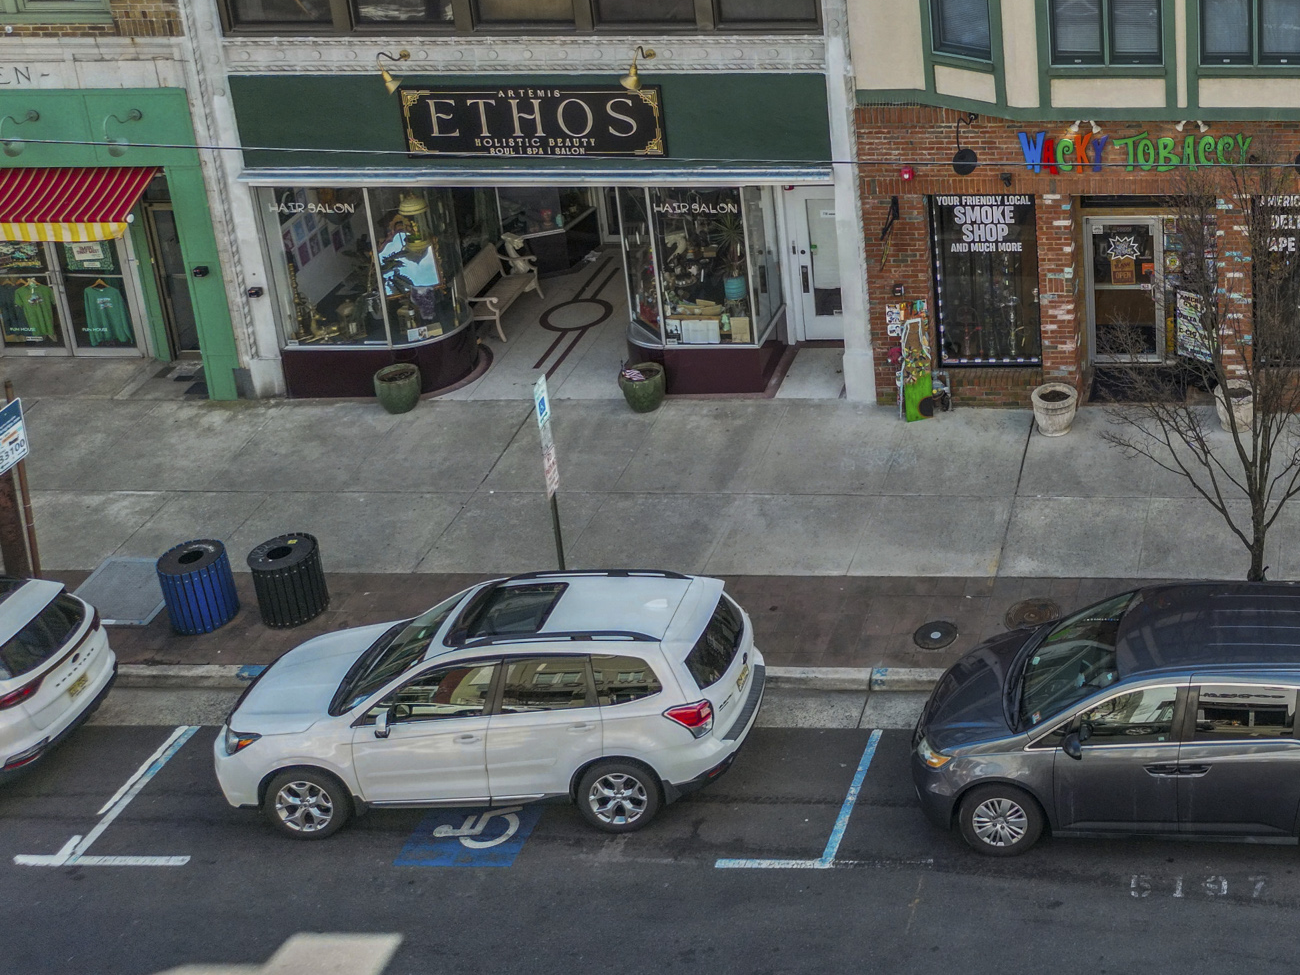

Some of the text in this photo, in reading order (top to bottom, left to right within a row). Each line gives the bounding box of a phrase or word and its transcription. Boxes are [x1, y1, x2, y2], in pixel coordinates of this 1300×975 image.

[498, 89, 561, 98] ARTEMIS
[425, 98, 638, 138] ETHOS
[474, 137, 596, 147] HOLISTIC BEAUTY
[489, 147, 586, 156] SOUL SPA SALON
[1017, 131, 1253, 175] WACKY TOBACCY
[936, 195, 1031, 206] YOUR FRIENDLY LOCAL
[268, 203, 355, 214] HAIR SALON
[653, 203, 739, 214] HAIR SALON
[954, 206, 1015, 224] SMOKE
[962, 224, 1009, 242] SHOP
[951, 242, 1023, 252] AND MUCH MORE
[1263, 237, 1296, 252] APE
